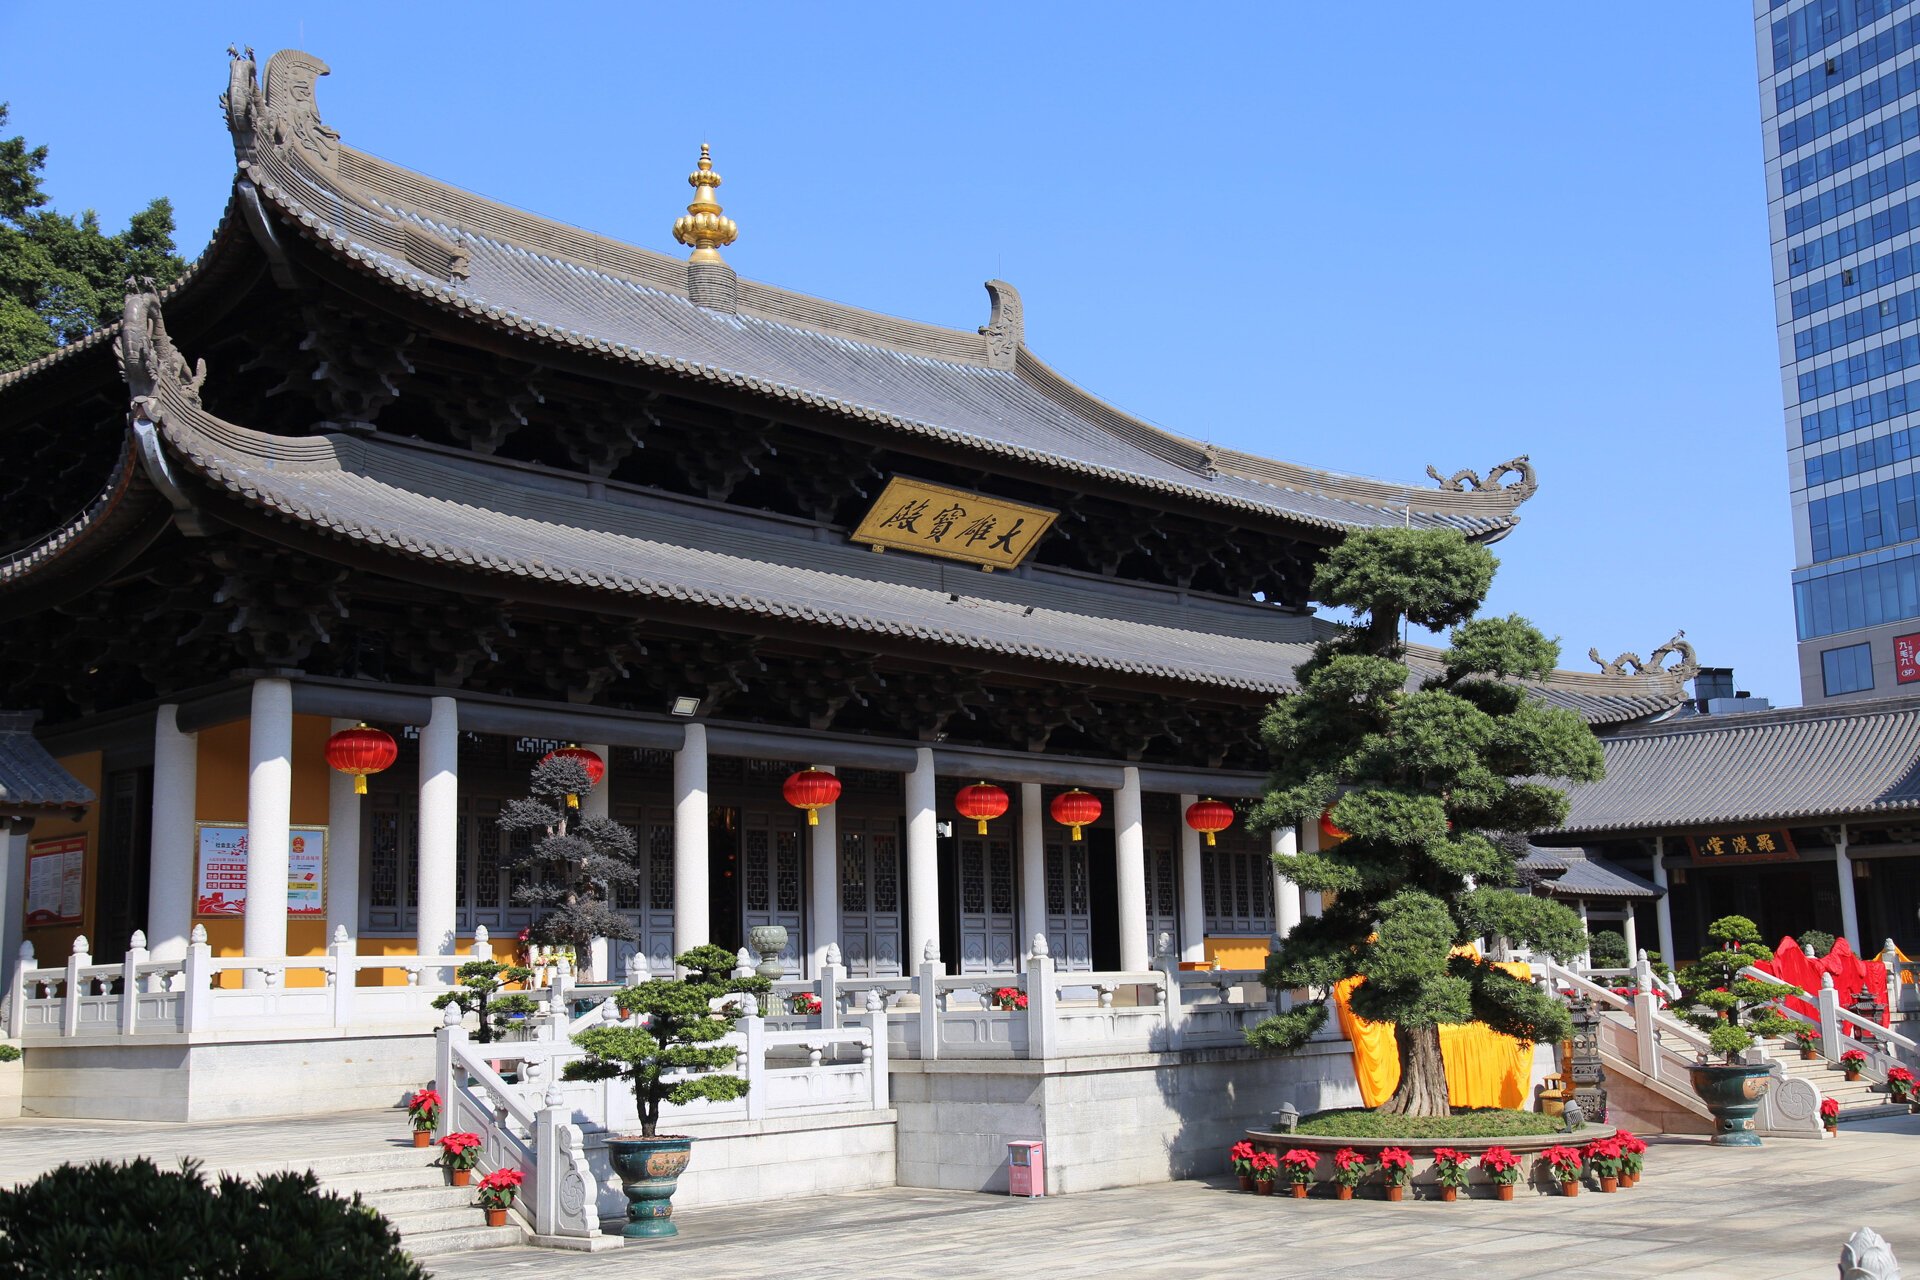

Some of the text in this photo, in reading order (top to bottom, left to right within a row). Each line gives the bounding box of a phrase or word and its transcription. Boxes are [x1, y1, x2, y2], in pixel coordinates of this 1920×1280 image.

[879, 498, 1025, 554] 大雄寶殿
[1898, 641, 1910, 666] 九毛九
[1706, 833, 1776, 856] 羅漢堂
